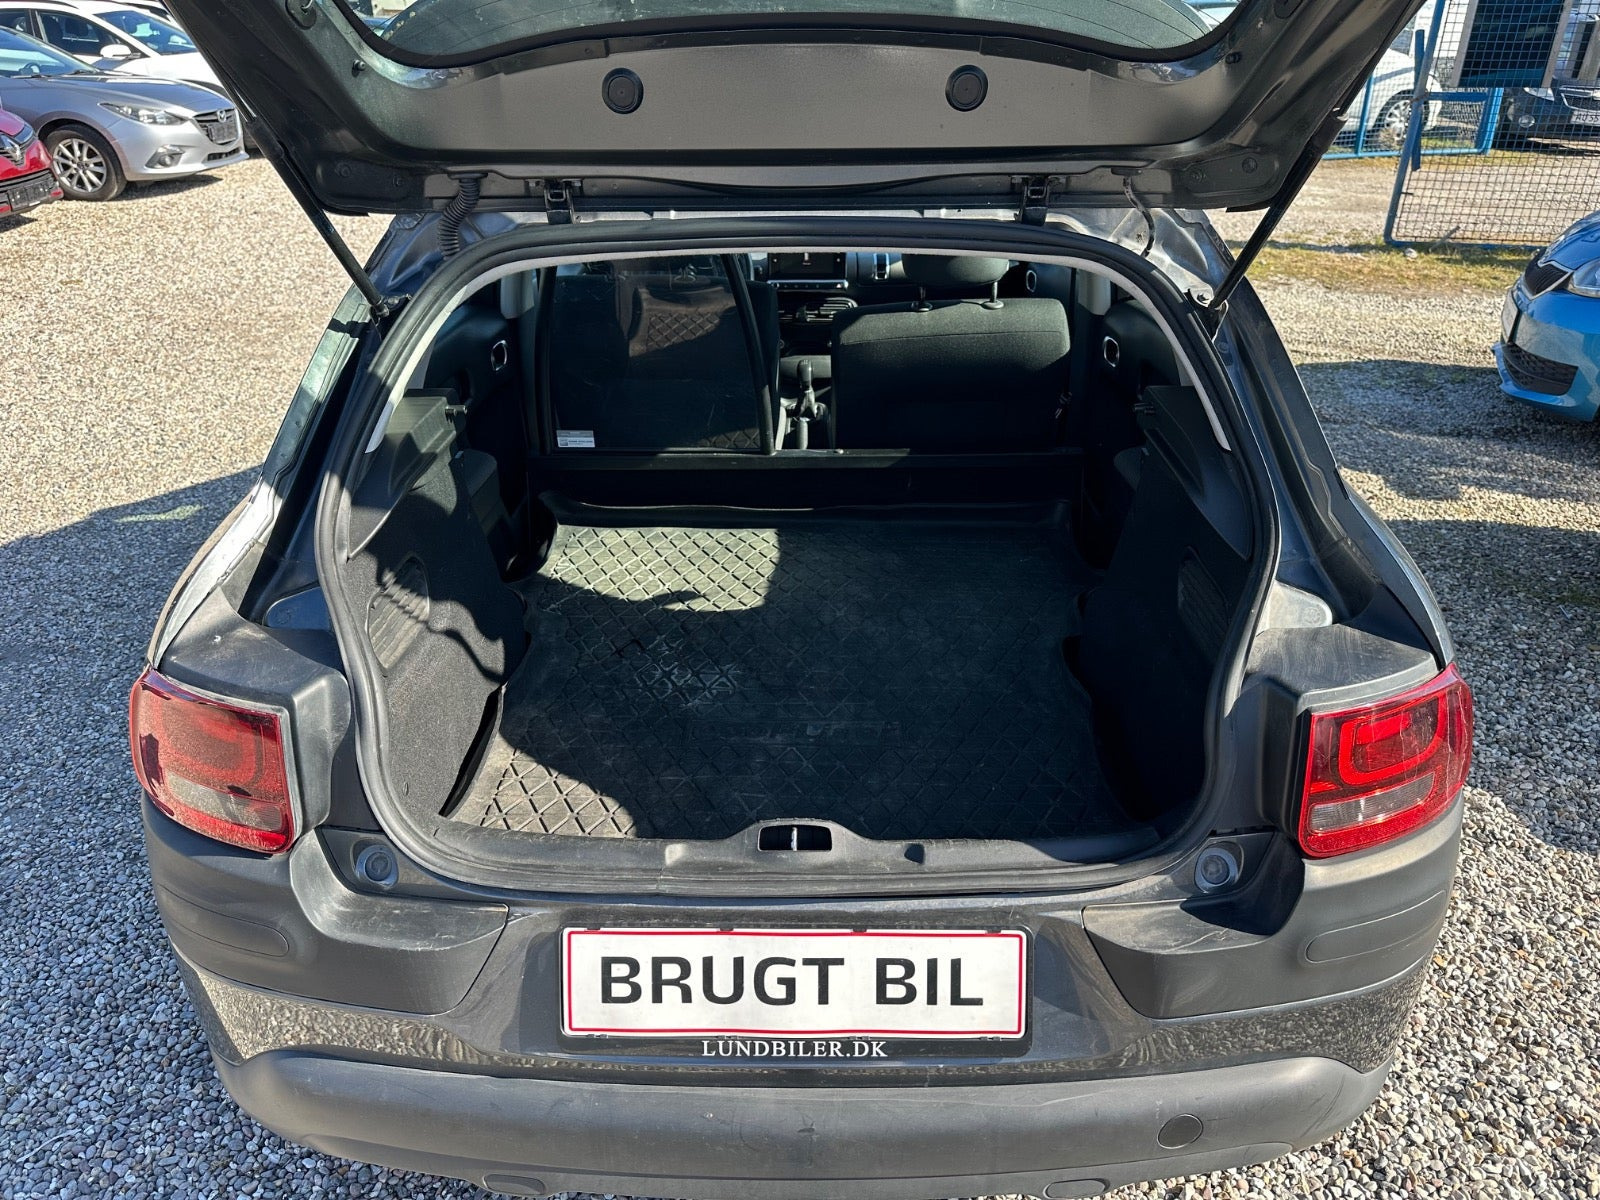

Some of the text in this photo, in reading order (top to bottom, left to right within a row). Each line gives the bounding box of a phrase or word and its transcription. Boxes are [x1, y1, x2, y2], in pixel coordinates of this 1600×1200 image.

[601, 955, 983, 1006] BRUGT BIL
[701, 1040, 888, 1058] LUNDBILER.DK
